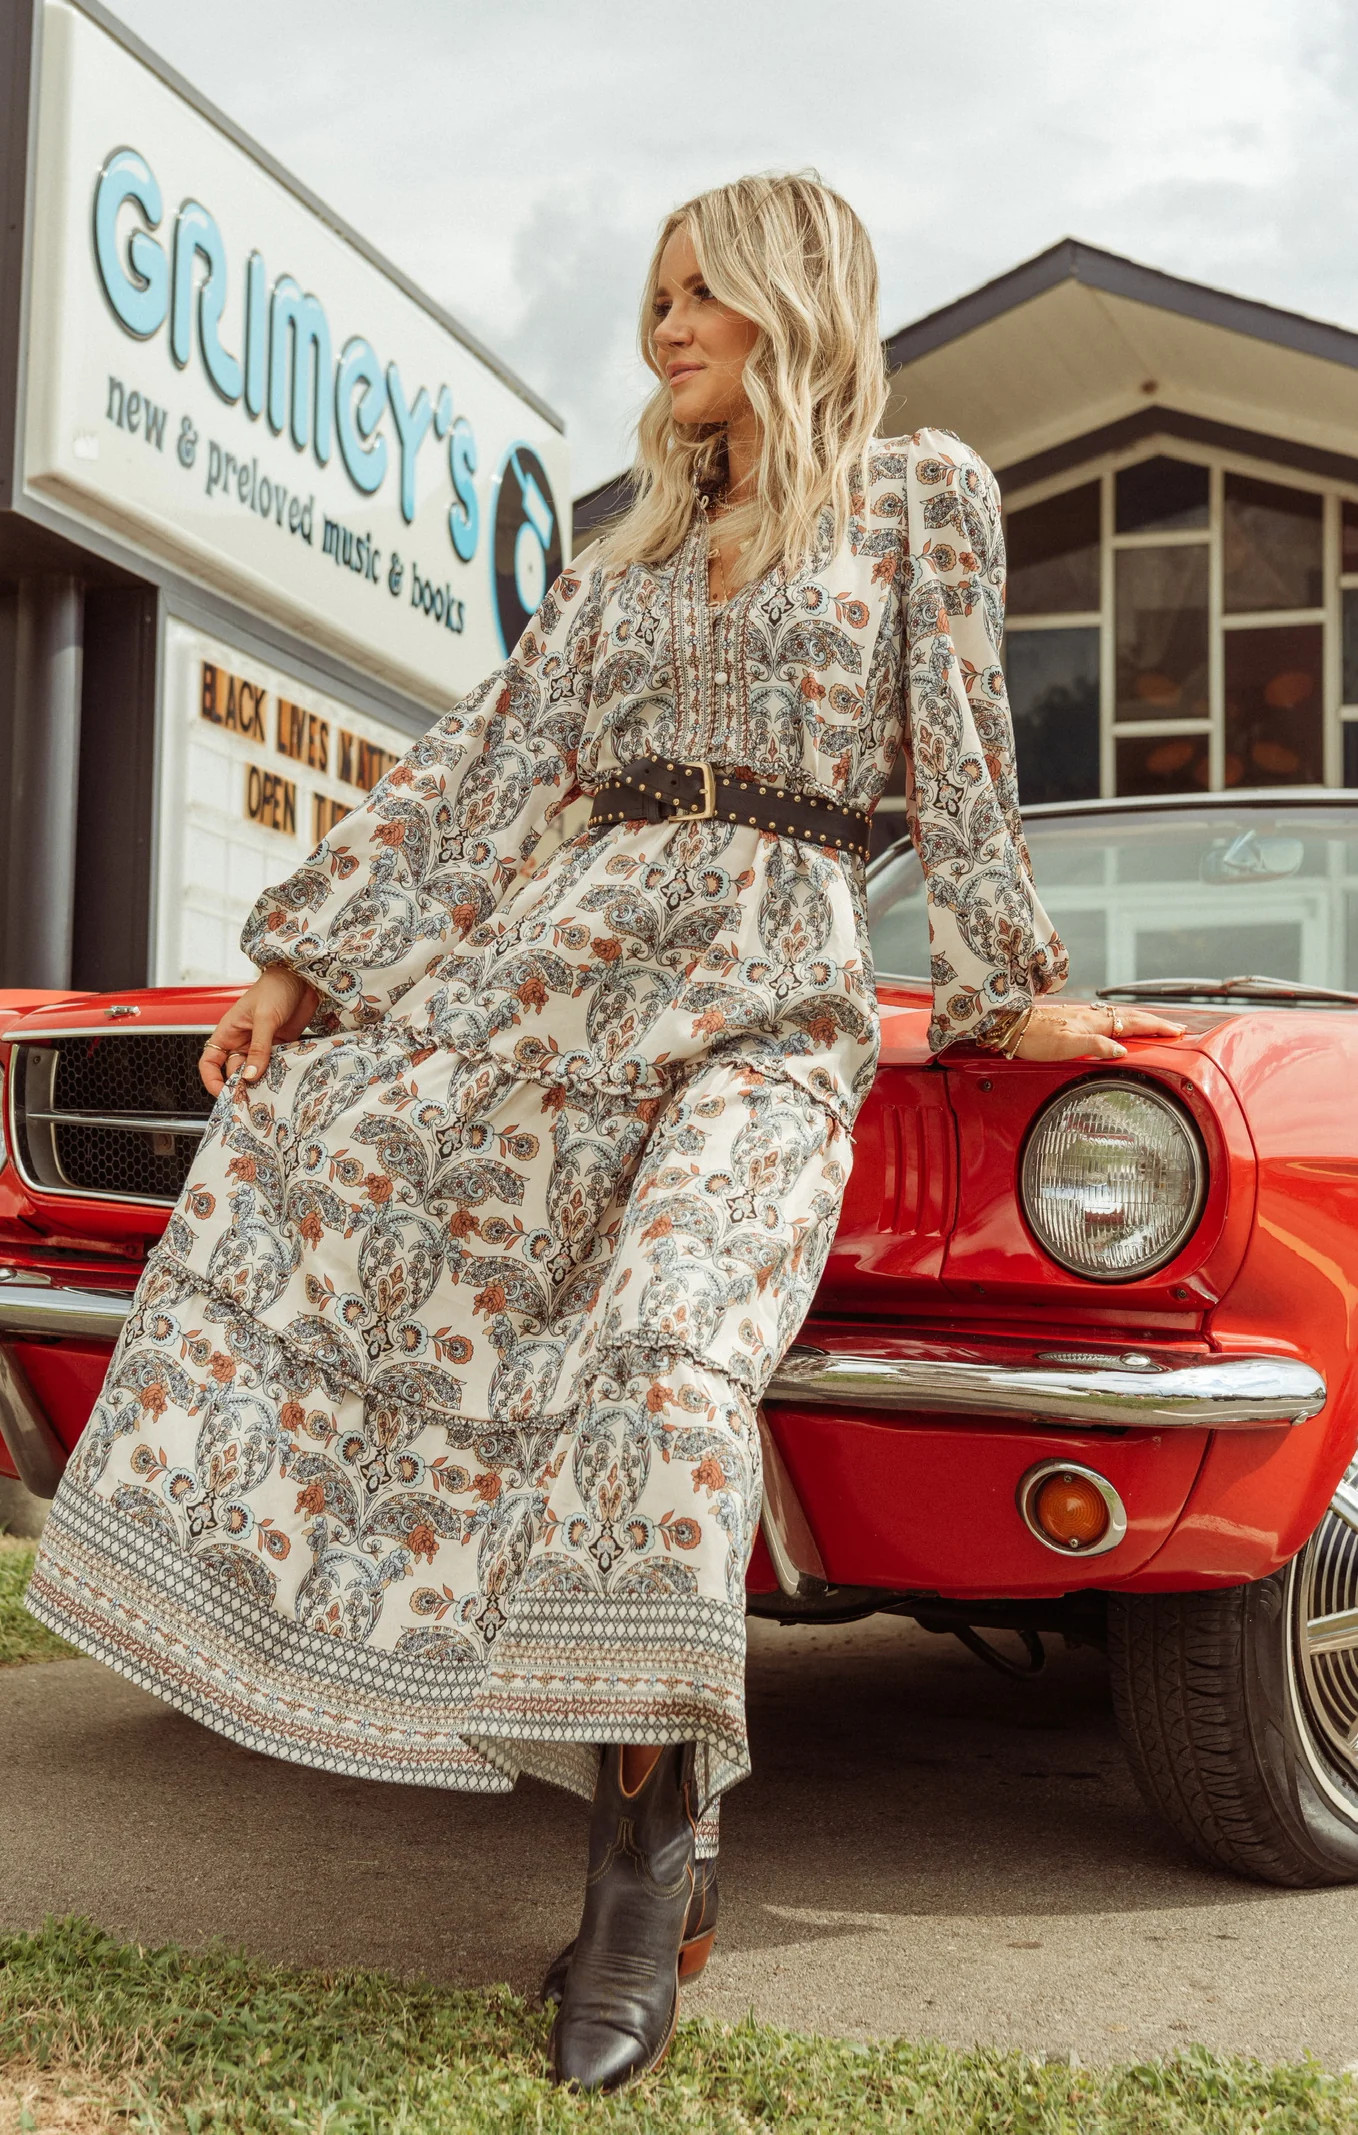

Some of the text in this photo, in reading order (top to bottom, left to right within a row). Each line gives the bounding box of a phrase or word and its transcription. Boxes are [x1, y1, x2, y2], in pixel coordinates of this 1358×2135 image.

[106, 374, 466, 636] new & preloved music & books
[202, 660, 267, 742] BLACK
[276, 698, 328, 774] LIVES
[247, 765, 296, 835] OPEN
